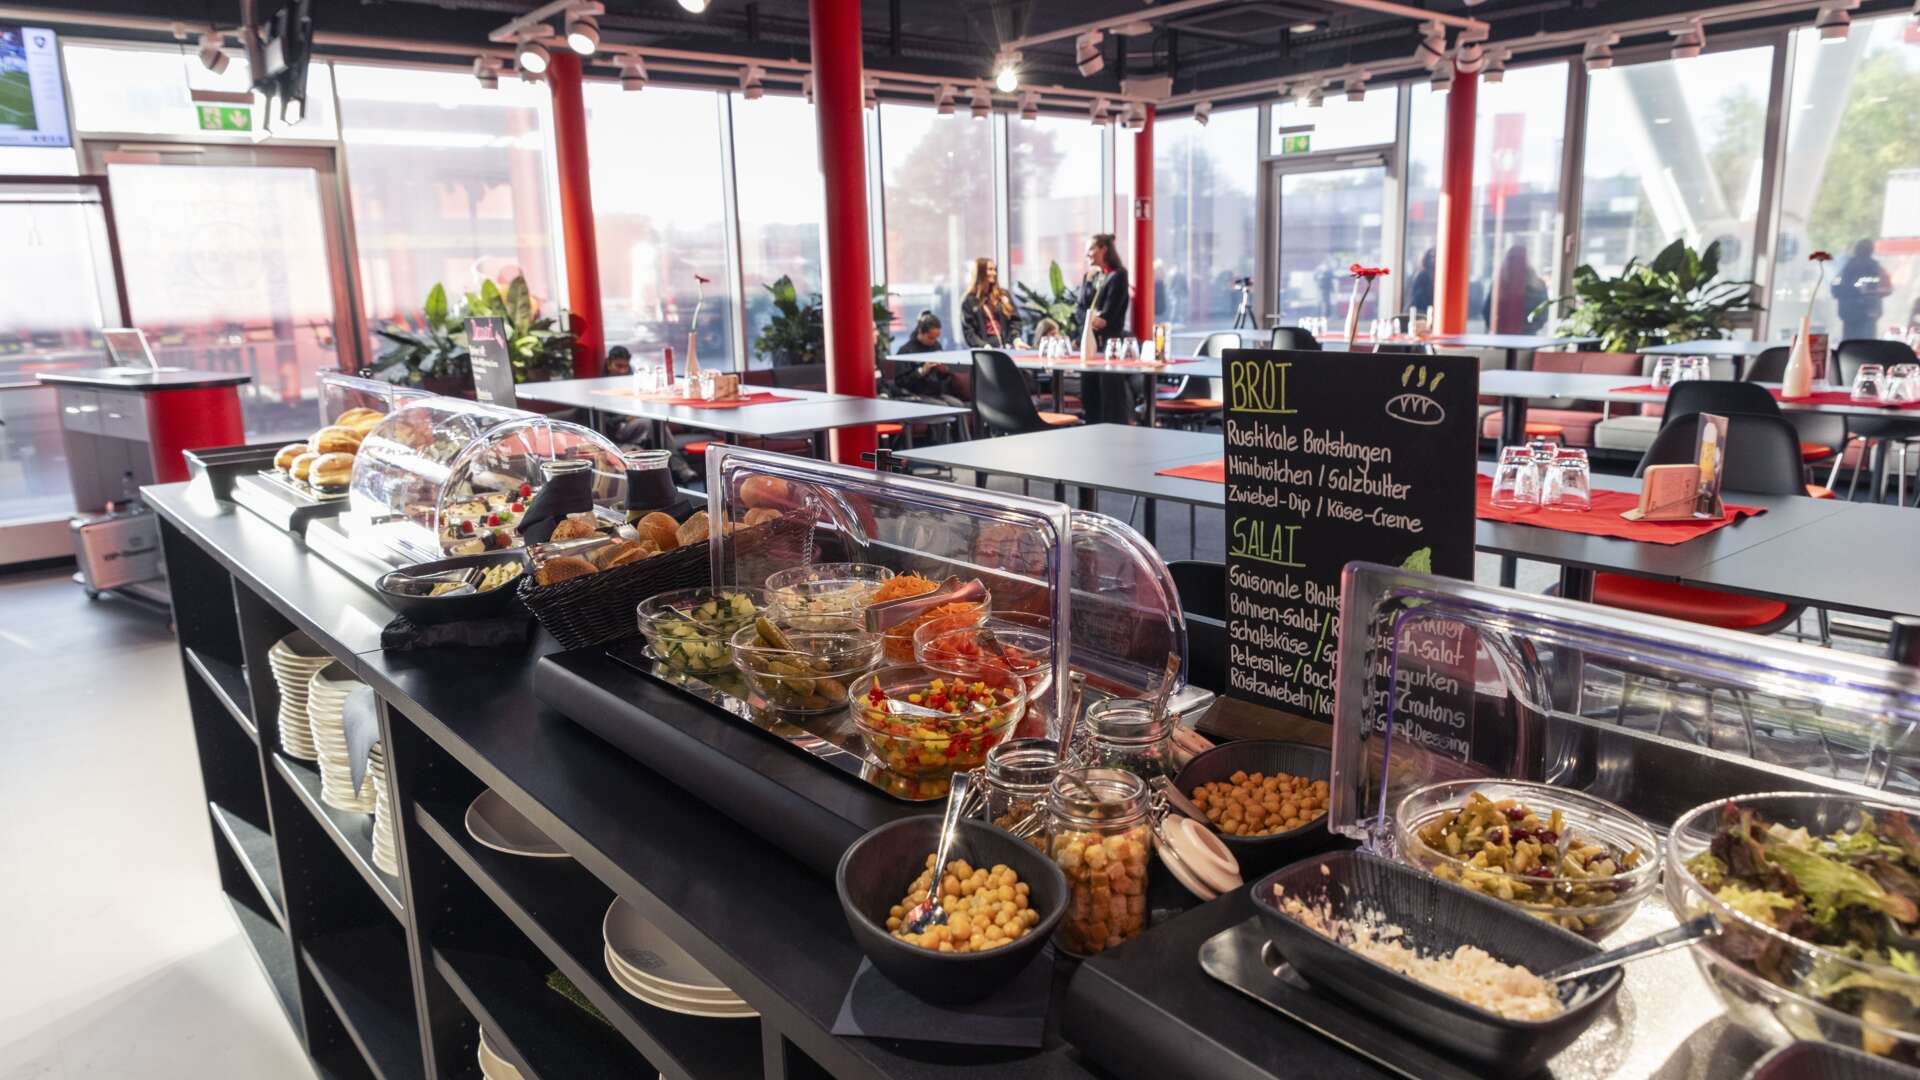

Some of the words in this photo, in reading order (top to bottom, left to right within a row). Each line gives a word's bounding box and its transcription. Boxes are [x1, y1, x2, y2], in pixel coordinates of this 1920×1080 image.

[1230, 359, 1293, 410] BROT
[1226, 419, 1299, 452] Rustikale
[1303, 428, 1392, 474] Brotstangen
[1228, 454, 1313, 487] Minibrötchen
[1327, 468, 1412, 501] Salzbutter
[1228, 484, 1311, 519] Zwiebel-Dip
[1326, 498, 1424, 533] Käse-Creme
[1231, 516, 1302, 564] SALAT
[1230, 564, 1302, 600] Saisonale
[1230, 592, 1322, 633] Bohnen-Salat
[1230, 619, 1312, 656] Schafskäse
[1230, 643, 1294, 678] Petersilie
[1399, 690, 1466, 729] Croutons
[1230, 667, 1313, 711] Röstzwiebeln
[1414, 723, 1470, 764] Dressing
